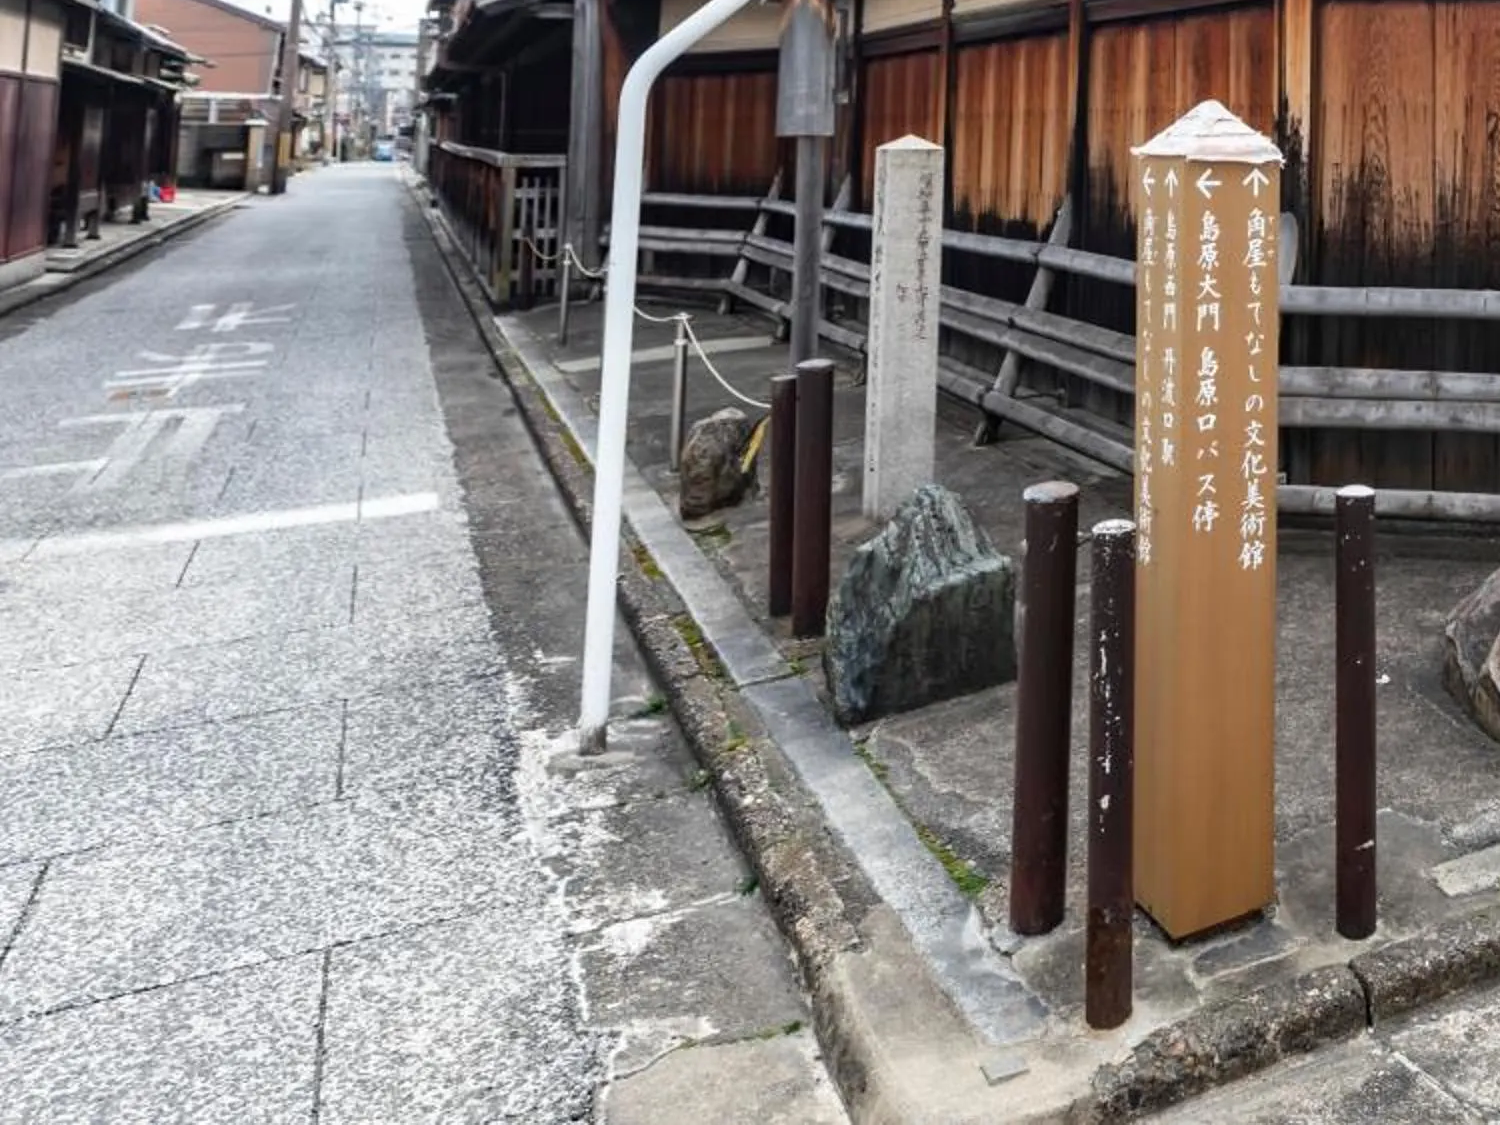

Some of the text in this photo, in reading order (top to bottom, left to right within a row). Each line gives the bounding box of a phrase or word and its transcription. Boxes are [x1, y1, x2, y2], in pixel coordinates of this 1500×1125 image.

[1192, 210, 1222, 533] 島原大門 島原口バス停
[1238, 206, 1268, 570] 角屋もてなしの文化美術館
